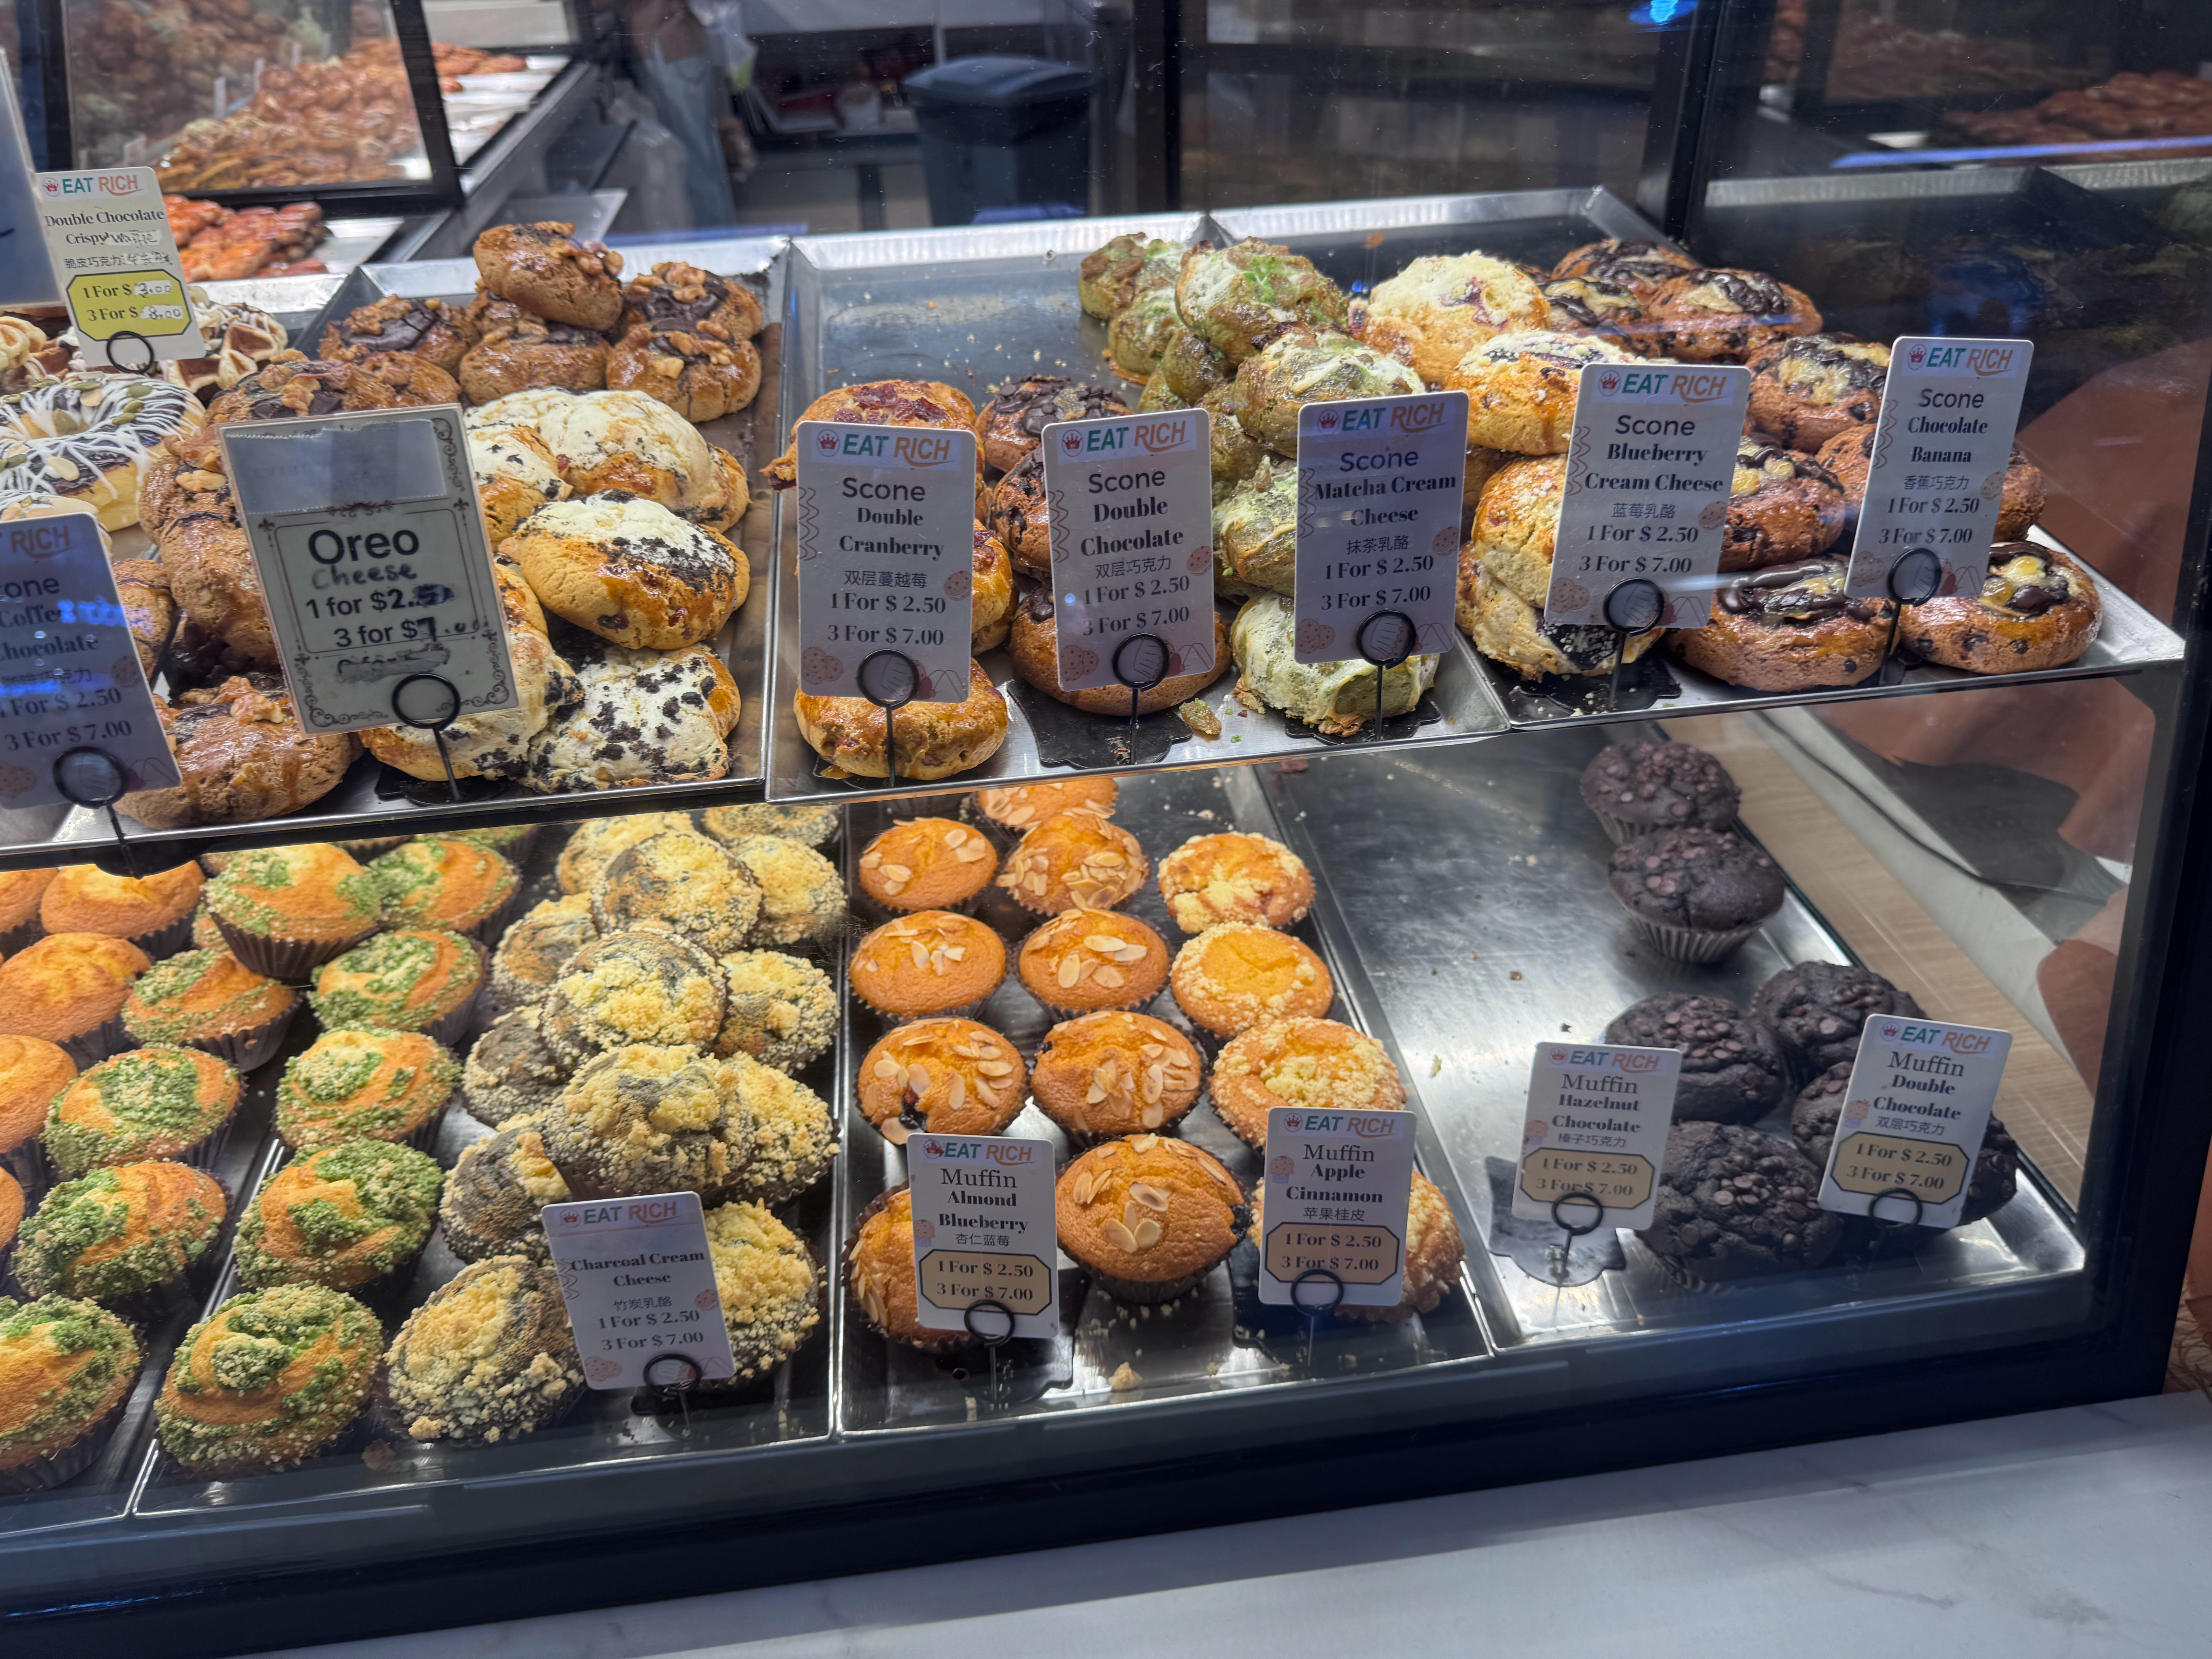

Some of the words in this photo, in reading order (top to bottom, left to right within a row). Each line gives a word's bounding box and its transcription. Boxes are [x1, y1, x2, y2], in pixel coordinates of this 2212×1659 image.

[62, 177, 93, 194] EAT
[98, 175, 143, 196] RICH
[45, 213, 94, 227] Double
[96, 210, 165, 223] Chocolate
[83, 288, 91, 298] 1
[92, 285, 118, 297] For
[86, 310, 97, 321] 3
[99, 308, 125, 319] For
[1926, 347, 1966, 368] EAT
[1966, 349, 2013, 376] RICH
[1622, 374, 1668, 394] EAT
[1670, 375, 1727, 404] RICH
[1918, 388, 1984, 409] Scone
[1342, 408, 1386, 431] EAT
[1390, 403, 1448, 433] RICH
[1615, 415, 1695, 436] Scone
[1908, 416, 1987, 434] Chocolate
[1087, 427, 1129, 452] EAT
[1134, 421, 1190, 452] RICH
[843, 434, 888, 457] EAT
[894, 437, 955, 467] RICH
[1607, 443, 1707, 467] Blueberry
[1911, 446, 1971, 463] Banana
[1339, 451, 1418, 472] Scone
[842, 477, 925, 501] Scone
[1089, 471, 1165, 493] Scone
[1316, 478, 1386, 500] Matcha
[1392, 476, 1456, 493] Cream
[1585, 472, 1649, 490] Cream
[1655, 474, 1723, 491] Cheese
[1094, 496, 1168, 522] Double
[1611, 503, 1675, 519] 蓝莓乳酪
[1887, 498, 1894, 513] 1
[1898, 498, 1928, 513] For
[1932, 498, 1940, 513] $
[1944, 498, 1979, 513] 2.50
[857, 507, 924, 526] Double
[1351, 508, 1418, 526] Cheese
[10, 526, 77, 559] RICH
[1081, 530, 1183, 556] Chocolate
[1587, 526, 1594, 540] 1
[1600, 525, 1635, 541] For
[1640, 526, 1651, 542] $
[1656, 526, 1698, 543] 2.50
[1879, 529, 1888, 544] 3
[1892, 529, 1922, 544] For
[1925, 527, 1936, 543] $
[1938, 529, 1972, 543] 7.00
[309, 529, 419, 564] Oreo
[840, 535, 945, 561] Cranberry
[1346, 535, 1409, 555] 抹茶乳酪
[1095, 556, 1171, 579] 双层巧克力
[1325, 565, 1331, 579] 1
[1338, 562, 1370, 579] For
[1377, 559, 1387, 576] $
[1393, 555, 1433, 572] 2.50
[1579, 556, 1590, 571] 3
[1595, 556, 1630, 572] For
[1635, 556, 1647, 573] $
[1651, 557, 1691, 573] 7.00
[845, 570, 927, 588] 双层蔓越莓
[1085, 590, 1091, 604] 1
[1097, 587, 1129, 603] For
[1135, 580, 1145, 599] $
[1151, 575, 1190, 596] 2.50
[1321, 596, 1331, 610] 3
[1337, 593, 1370, 608] For
[1376, 589, 1386, 606] $
[1392, 586, 1431, 603] 7.00
[306, 599, 320, 618] 1
[326, 597, 362, 617] for
[831, 593, 837, 609] 1
[844, 593, 879, 610] For
[886, 595, 896, 612] $
[903, 596, 946, 613] 2.50
[334, 628, 352, 647] 3
[358, 625, 393, 644] for
[827, 625, 838, 641] 3
[845, 625, 879, 643] For
[886, 628, 896, 644] $
[903, 629, 943, 645] 7.00
[5, 734, 19, 750] 3
[22, 732, 60, 748] For
[67, 726, 81, 742] $
[83, 720, 131, 740] 7.00
[1900, 1027, 1942, 1044] EAT
[1941, 1032, 1991, 1054] RICH
[1570, 1051, 1609, 1066] EAT
[1611, 1053, 1661, 1073] RICH
[1887, 1051, 1964, 1077] Muffin
[1561, 1074, 1638, 1094] Muffin
[1892, 1075, 1955, 1095] Double
[1559, 1094, 1640, 1111] Hazelnut
[1873, 1096, 1961, 1120] Chocolate
[1305, 1116, 1343, 1131] EAT
[1346, 1117, 1397, 1138] RICH
[1552, 1115, 1640, 1133] Chocolate
[1875, 1116, 1944, 1136] 双层巧克力
[944, 1142, 981, 1159] EAT
[986, 1145, 1036, 1166] RICH
[1303, 1144, 1374, 1162] Muffin
[1856, 1143, 1863, 1154] 1
[1867, 1144, 1897, 1159] For
[1901, 1148, 1911, 1161] $
[1915, 1151, 1951, 1166] 2.50
[1311, 1164, 1365, 1181] Apple
[1543, 1158, 1548, 1168] 1
[1553, 1159, 1582, 1171] For
[1587, 1160, 1596, 1173] $
[1601, 1163, 1637, 1175] 2.50
[941, 1168, 1017, 1188] Muffin
[948, 1190, 1017, 1207] Almond
[1286, 1186, 1382, 1203] Cinnamon
[584, 1206, 623, 1224] EAT
[629, 1201, 683, 1224] RICH
[1304, 1207, 1365, 1221] 苹果桂皮
[939, 1213, 1028, 1234] Blueberry
[955, 1233, 1010, 1247] 杏仁蓝莓
[1286, 1234, 1291, 1245] 1
[1297, 1233, 1326, 1245] For
[1331, 1234, 1340, 1247] $
[1345, 1236, 1381, 1248] 2.50
[571, 1254, 646, 1271] Charcoal
[649, 1252, 704, 1265] Cream
[938, 1261, 944, 1272] 1
[949, 1261, 978, 1273] For
[983, 1262, 992, 1276] $
[998, 1264, 1033, 1277] 2.50
[1281, 1257, 1291, 1268] 3
[1296, 1257, 1325, 1269] For
[1329, 1257, 1339, 1270] $
[1344, 1258, 1378, 1271] 7.00
[614, 1274, 672, 1287] Cheese
[937, 1283, 946, 1295] 3
[951, 1284, 979, 1297] For
[985, 1285, 994, 1298] $
[999, 1288, 1033, 1300] 7.00
[602, 1339, 612, 1351] 3
[617, 1337, 647, 1350] For
[652, 1334, 662, 1347] $
[666, 1331, 704, 1345] 7.00
